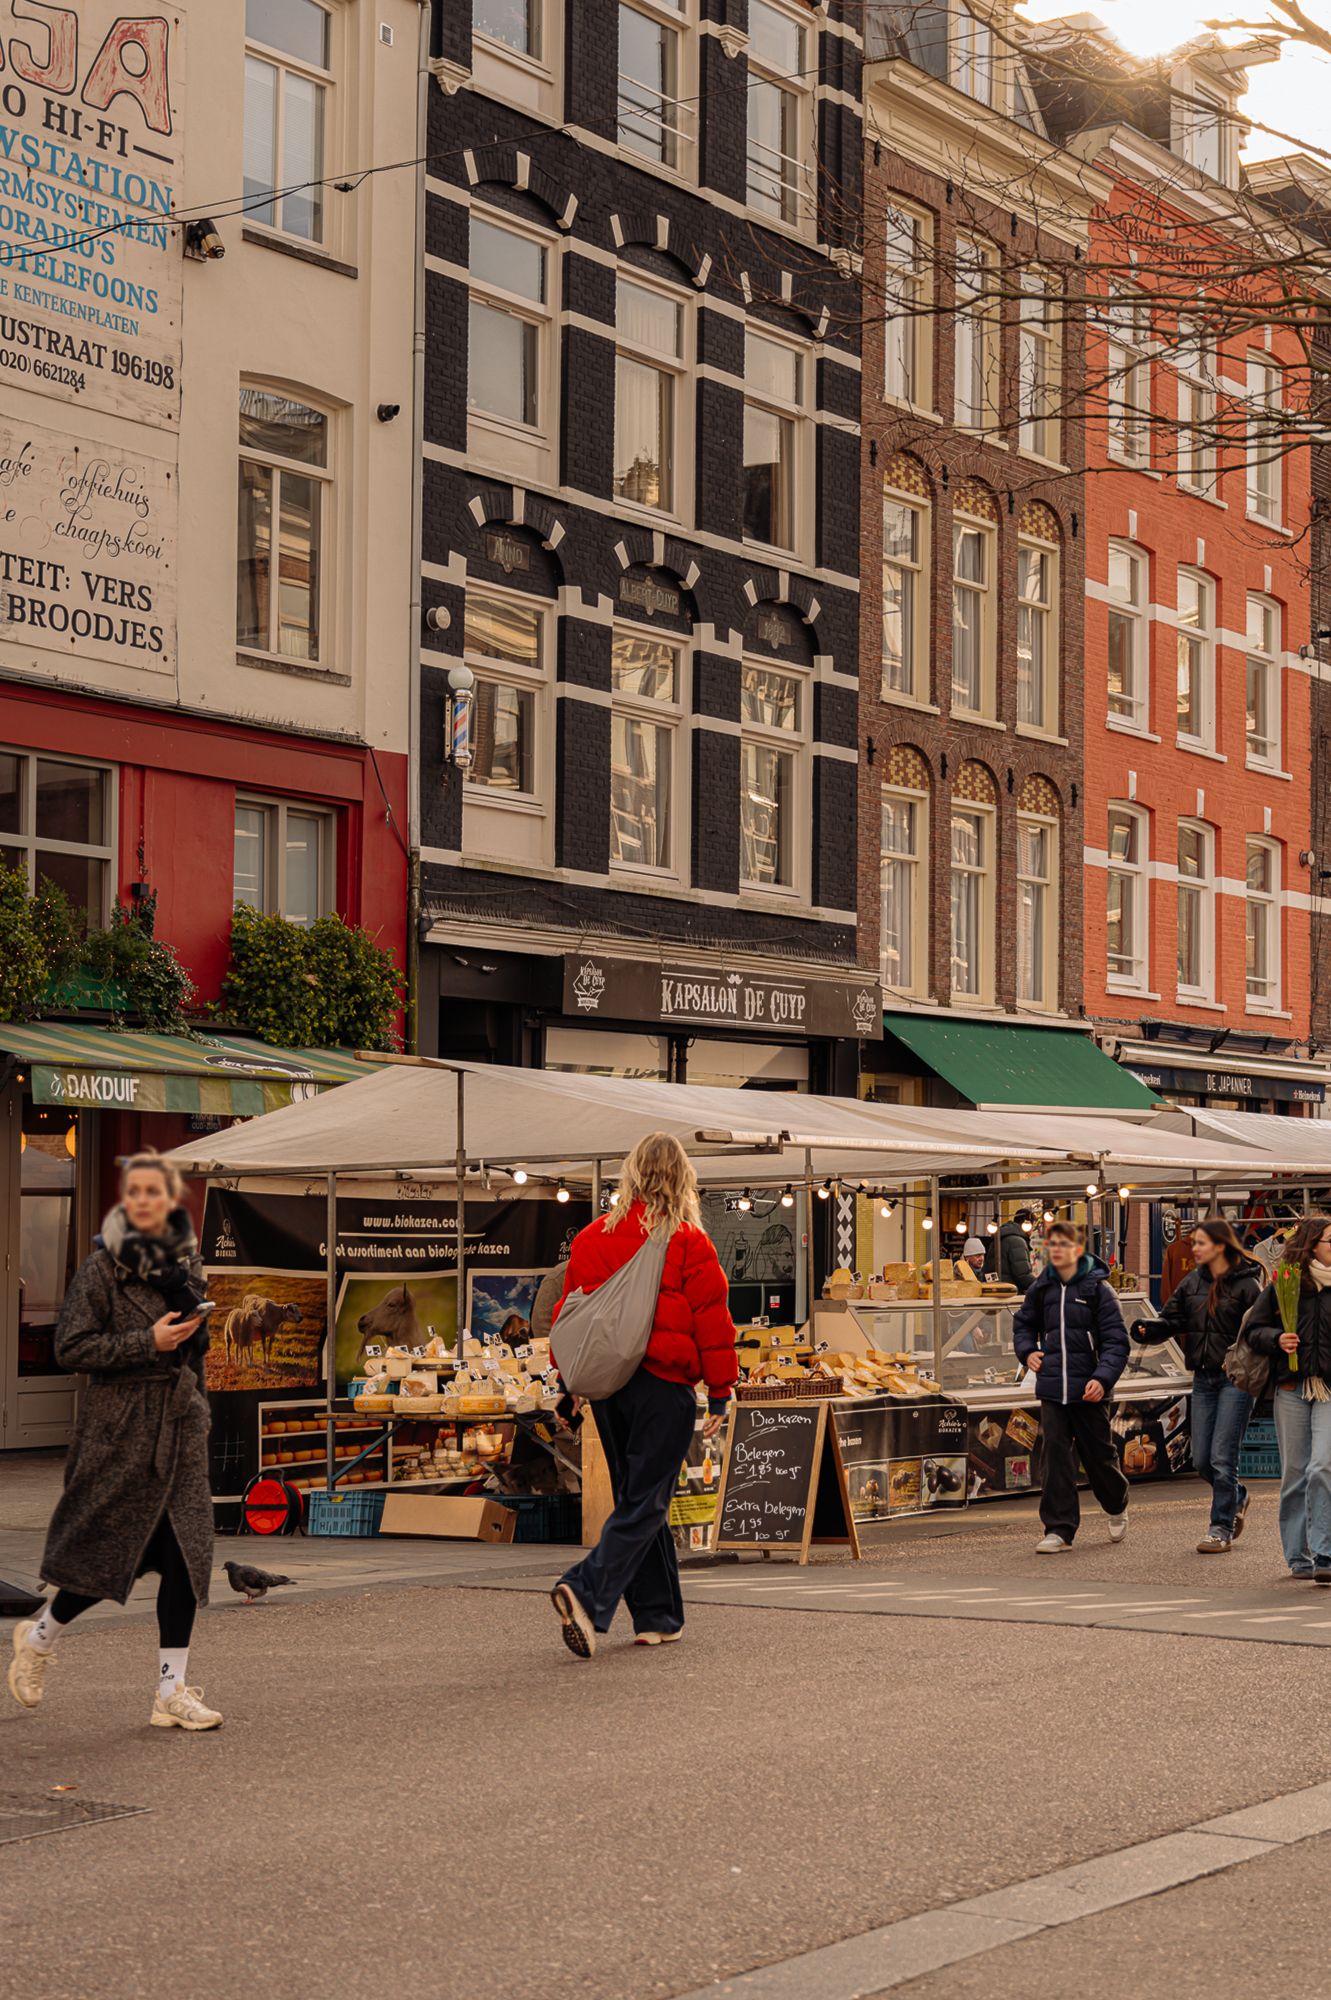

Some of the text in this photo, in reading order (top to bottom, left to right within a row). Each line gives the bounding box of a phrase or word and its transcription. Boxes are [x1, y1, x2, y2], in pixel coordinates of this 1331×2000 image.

[14, 283, 139, 337] KENTEKENPLATEN
[0, 314, 107, 369] USTRAAT
[33, 358, 86, 390] 6621284
[493, 536, 524, 564] ANNO
[0, 550, 153, 612] TEIT: VERS
[6, 593, 164, 653] BROODJES
[660, 978, 806, 1023] KAPSALON DE CUYP
[66, 1074, 140, 1102] DAKDUIF
[1206, 1074, 1217, 1092] DE
[1218, 1074, 1253, 1095] JAPANNER
[363, 1215, 465, 1229] www.biokazen.co
[347, 1244, 402, 1259] assortiment
[405, 1247, 426, 1258] aan
[477, 1242, 510, 1255] kazen
[735, 1443, 785, 1464] Belegen
[725, 1499, 761, 1513] Extra
